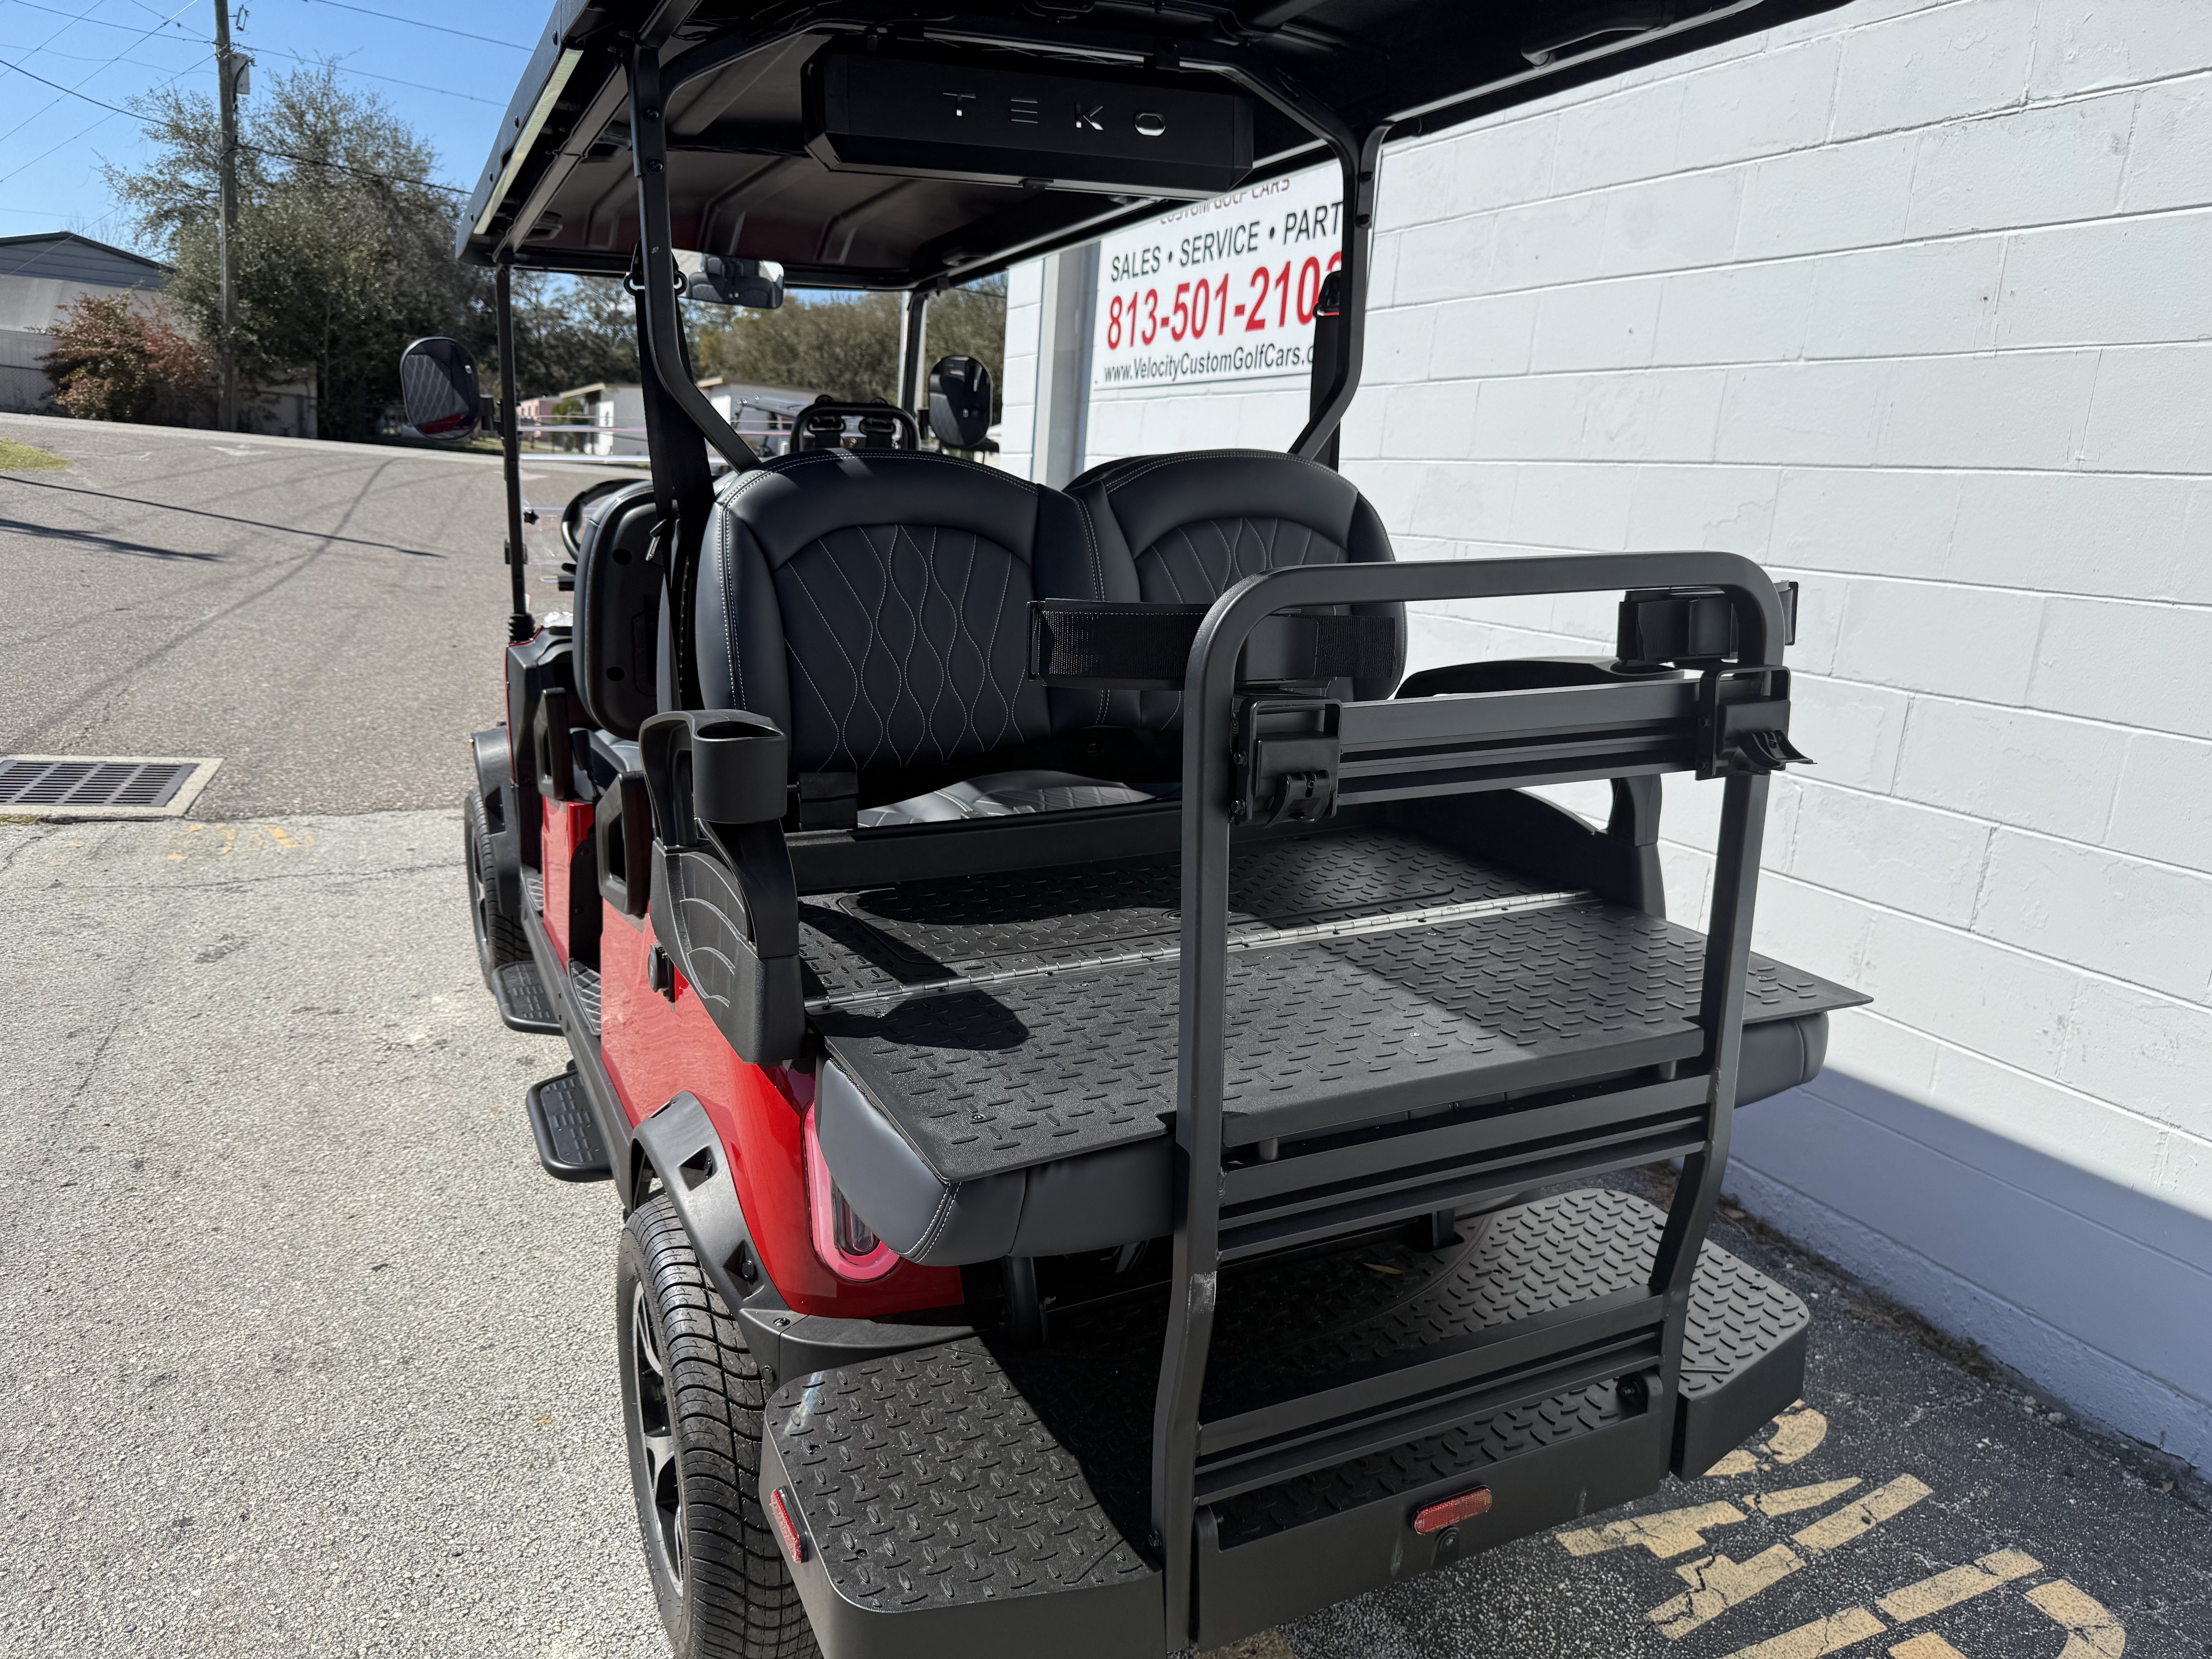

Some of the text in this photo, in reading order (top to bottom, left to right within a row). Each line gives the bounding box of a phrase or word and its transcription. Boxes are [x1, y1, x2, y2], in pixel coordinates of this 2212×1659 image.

[942, 90, 1166, 136] TEKO
[1111, 246, 1160, 282] SALES
[1180, 220, 1261, 267] SERVICE
[1107, 251, 1342, 350] 813-501-210
